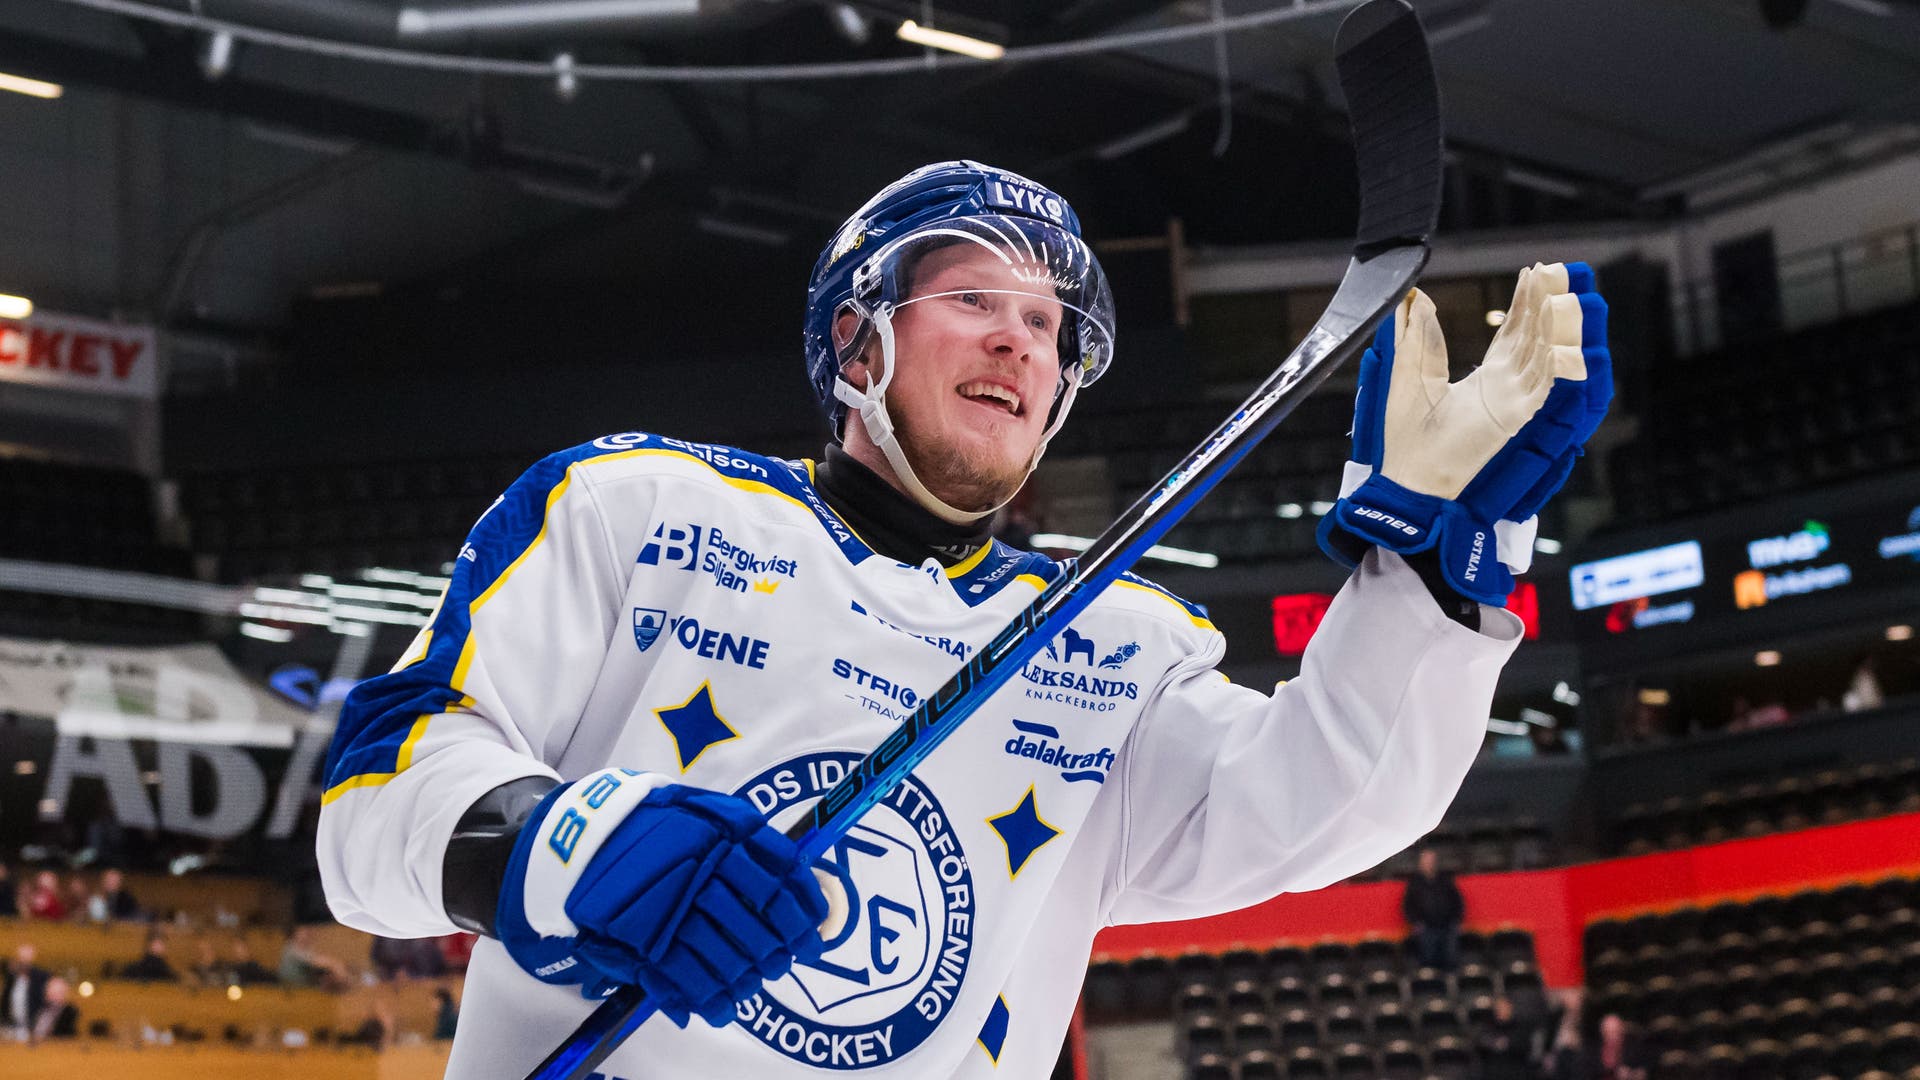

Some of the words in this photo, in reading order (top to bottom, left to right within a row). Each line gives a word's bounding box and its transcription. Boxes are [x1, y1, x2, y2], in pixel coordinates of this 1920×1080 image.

[801, 485, 851, 544] TEGERA
[702, 551, 749, 593] Siljan
[708, 527, 798, 578] Bergkvist
[1020, 659, 1139, 700] LEKSANDS
[1004, 734, 1116, 772] dalakraft
[806, 758, 970, 1022] IDTTSFÖRENING
